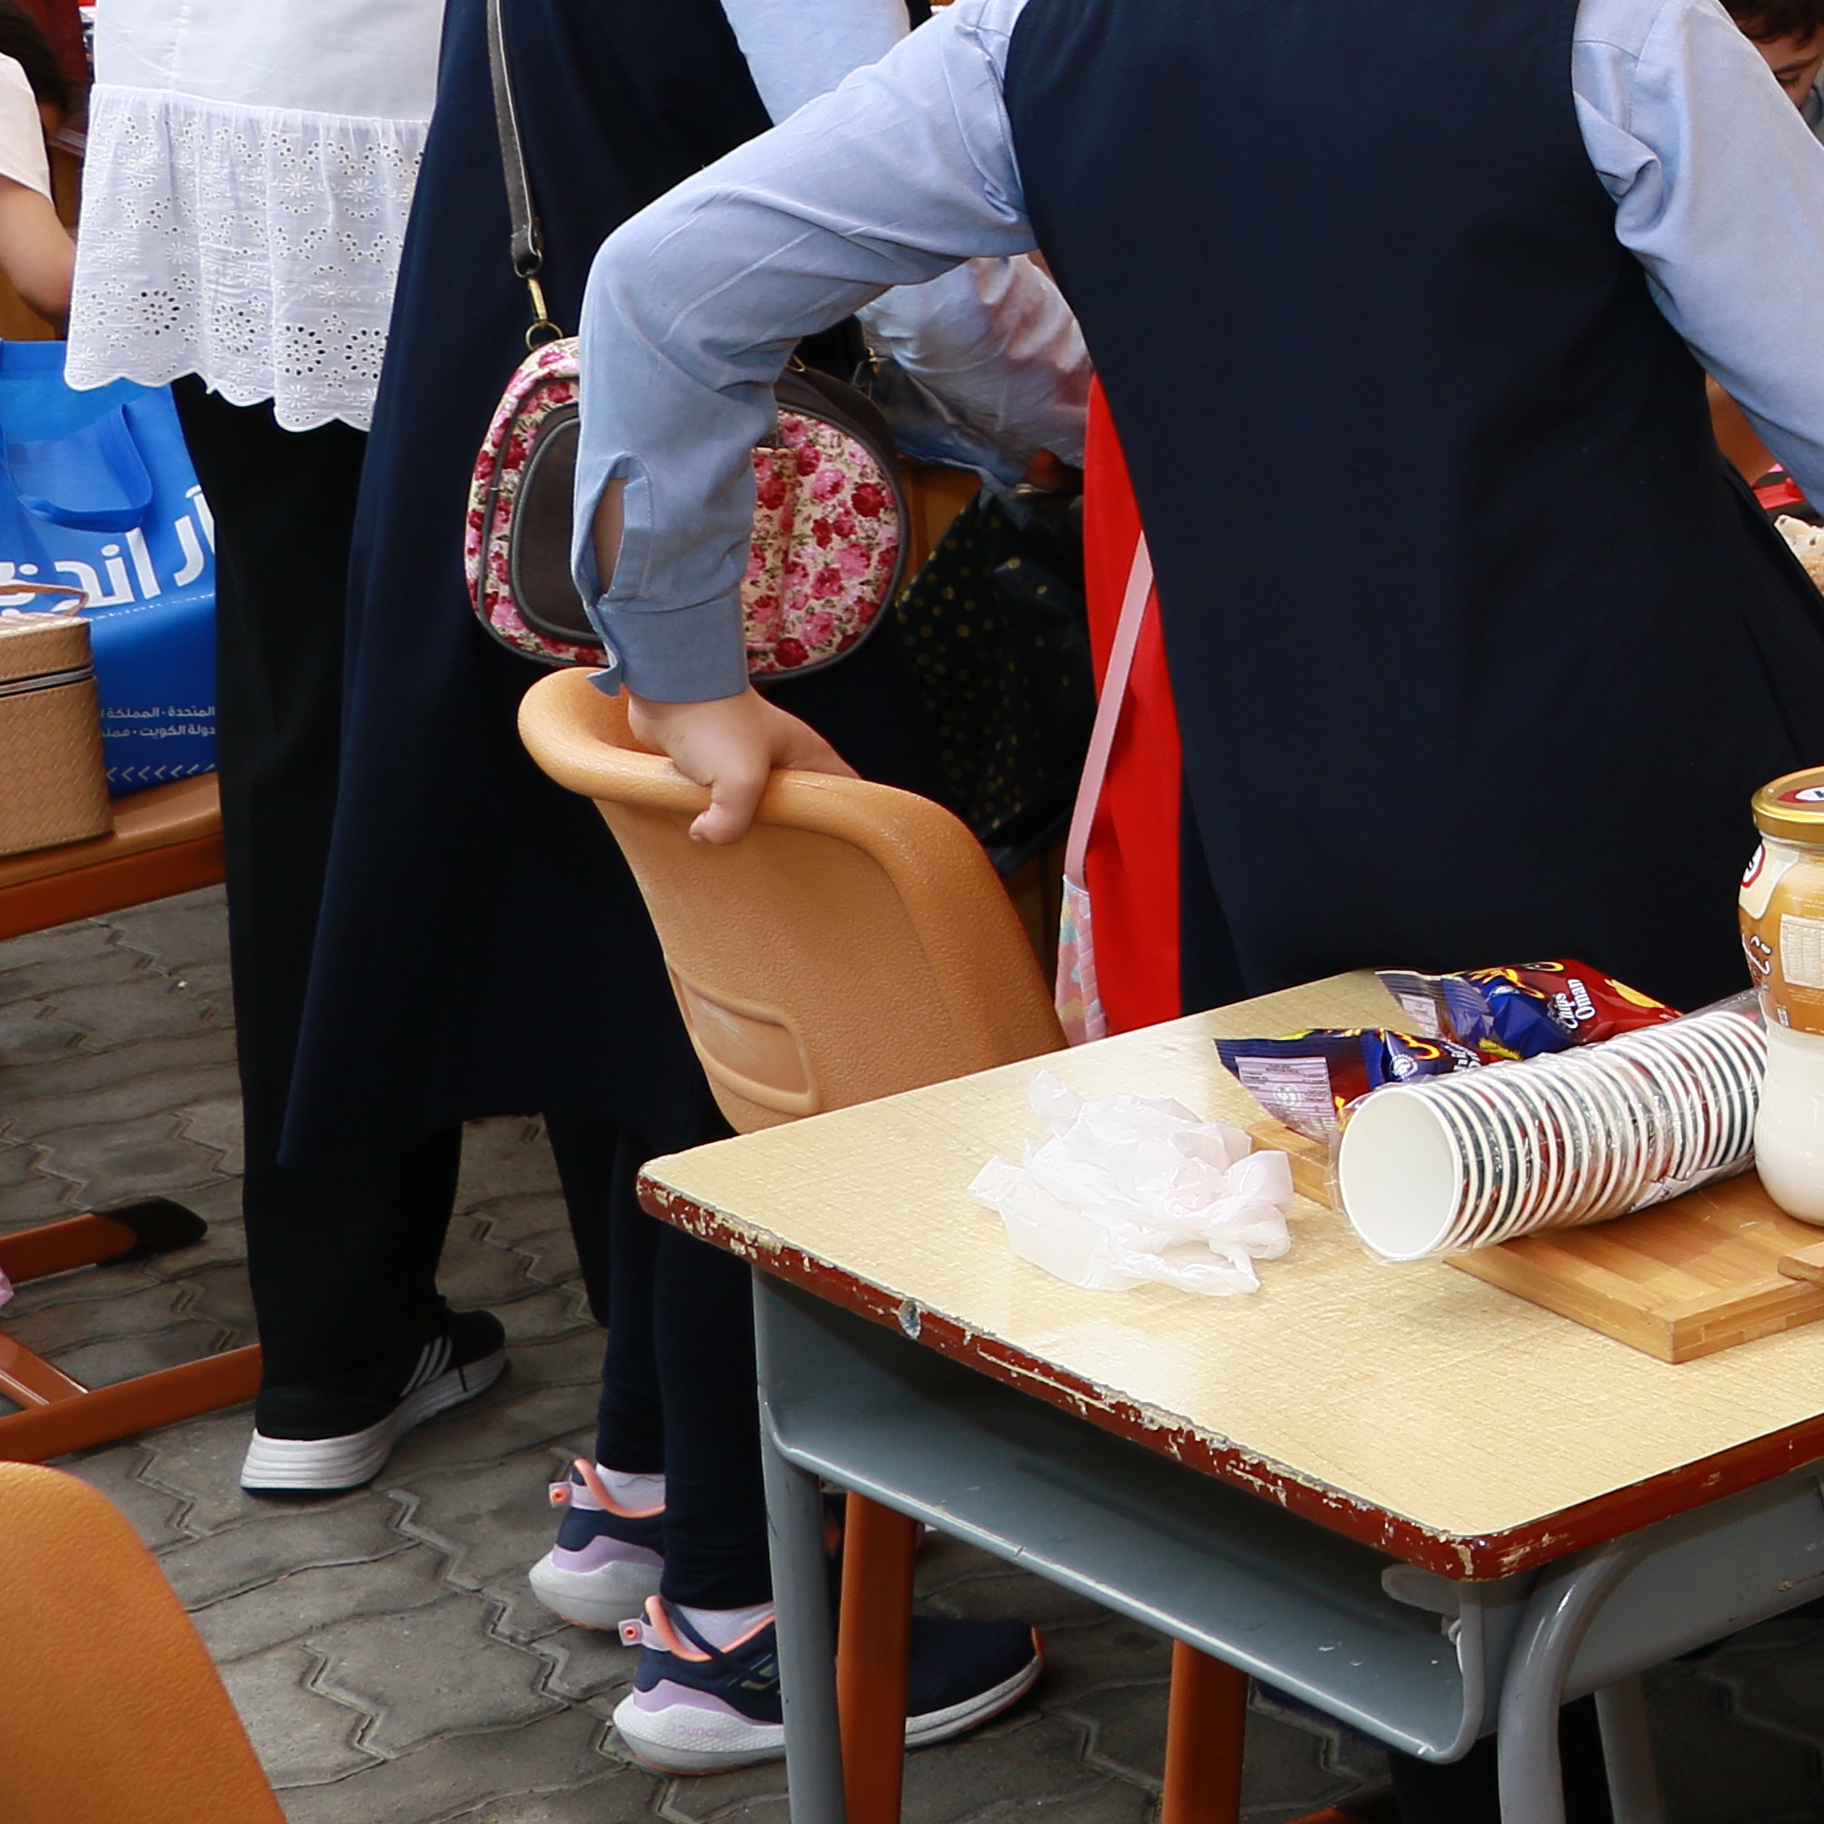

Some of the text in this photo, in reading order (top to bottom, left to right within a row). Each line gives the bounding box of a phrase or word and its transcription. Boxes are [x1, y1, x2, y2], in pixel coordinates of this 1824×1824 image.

[139, 724, 186, 739] الكويت
[187, 724, 216, 737] دولة
[1553, 992, 1579, 1029] Chips
[1567, 978, 1596, 1020] Oman
